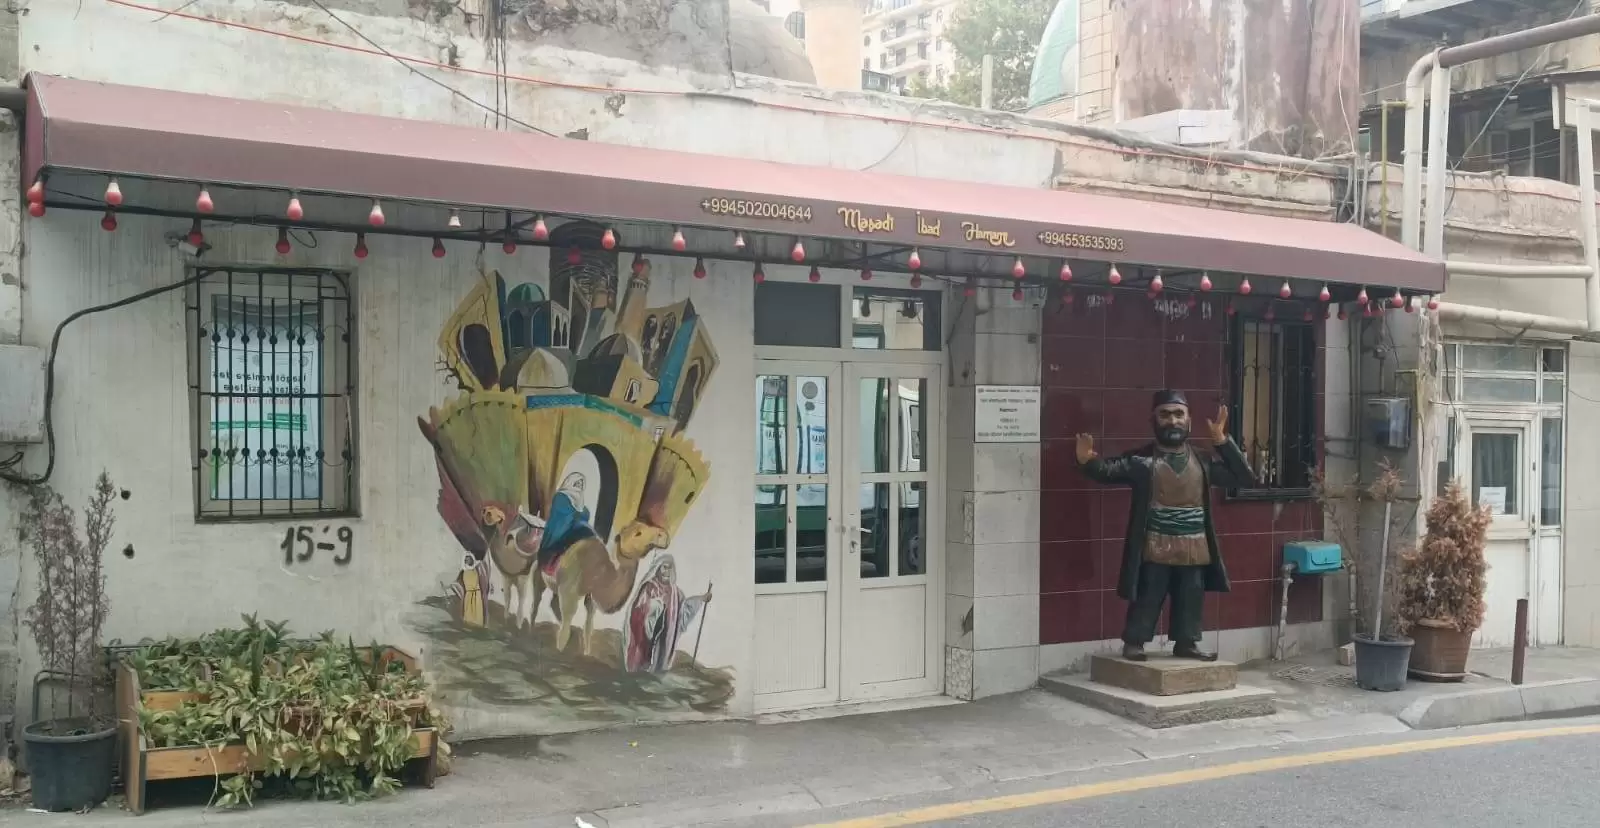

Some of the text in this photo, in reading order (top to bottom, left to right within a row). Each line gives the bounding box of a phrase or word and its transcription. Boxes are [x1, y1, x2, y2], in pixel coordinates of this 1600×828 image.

[702, 198, 812, 220] +994502004644
[916, 211, 941, 237] İbad
[1038, 231, 1125, 251] +994553535393
